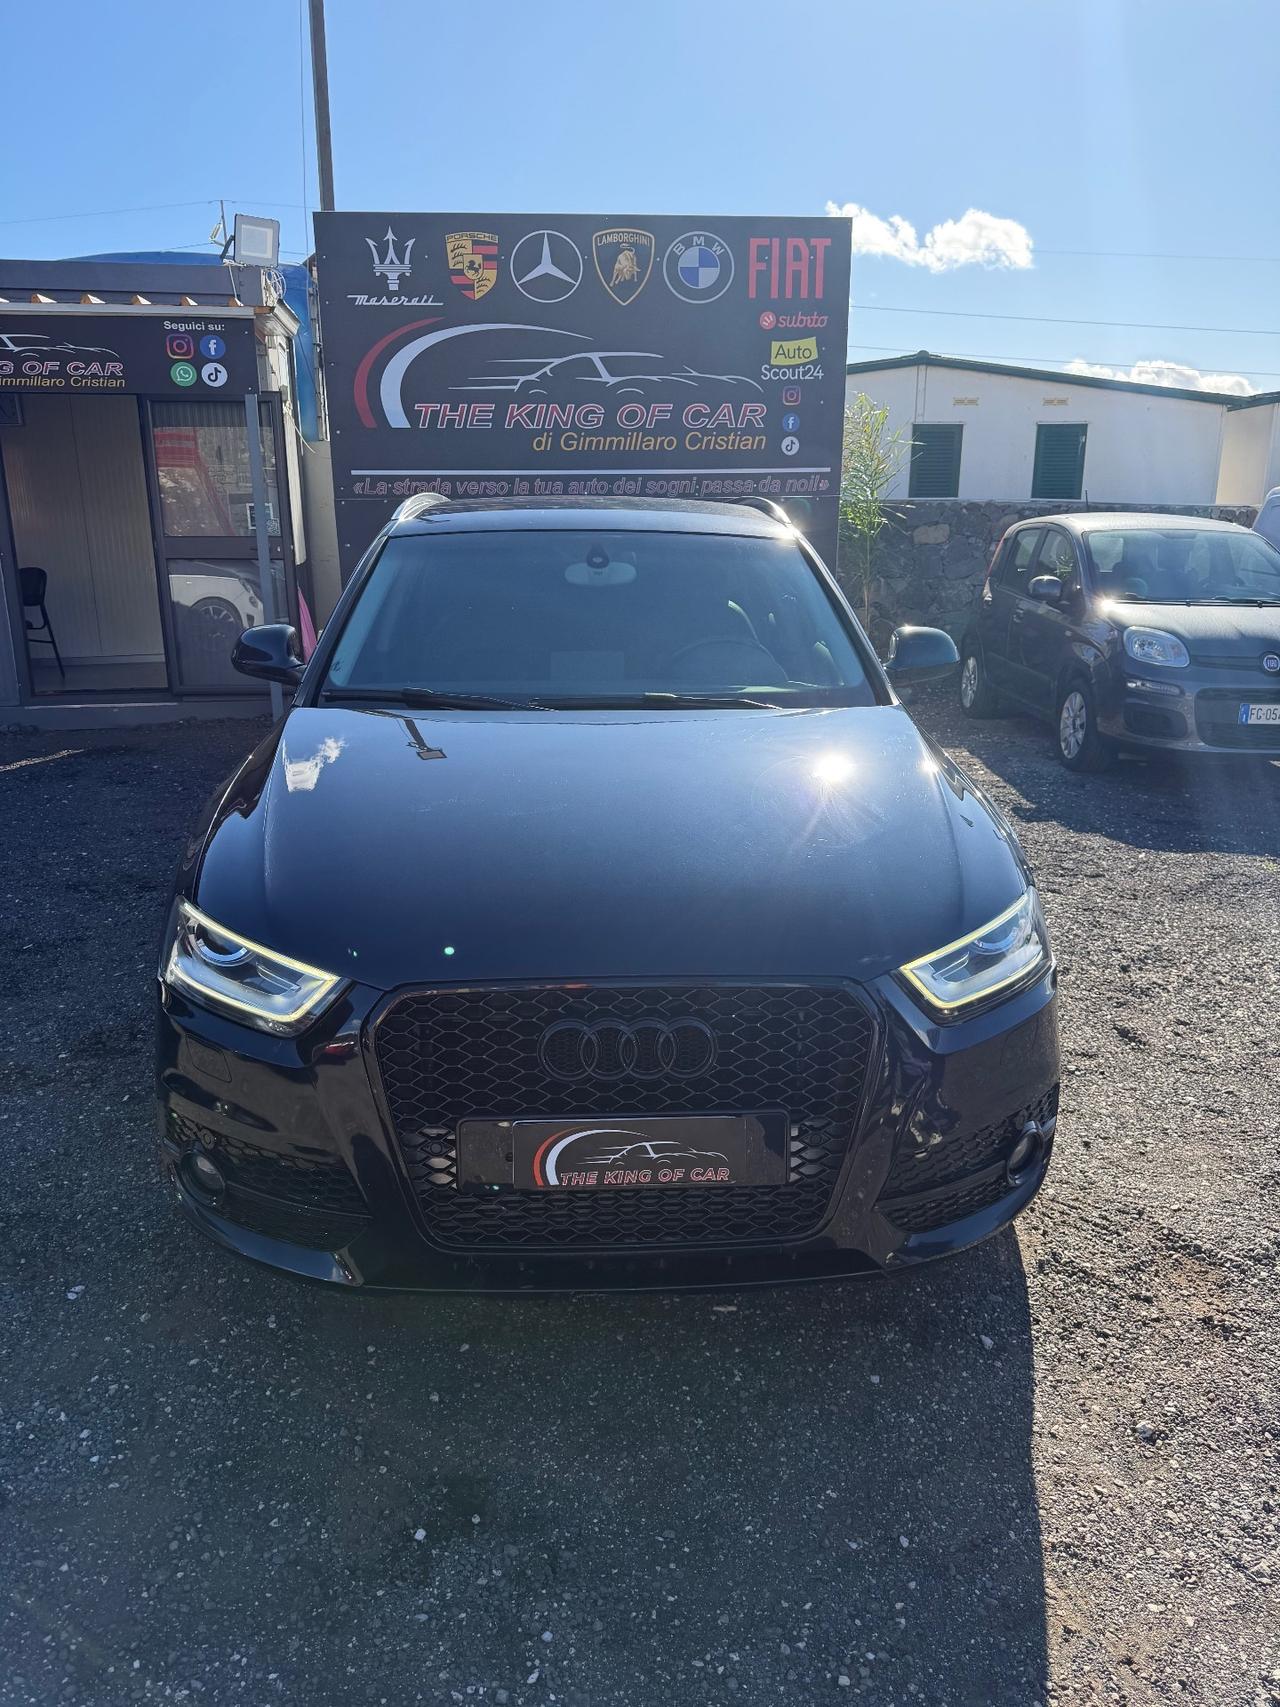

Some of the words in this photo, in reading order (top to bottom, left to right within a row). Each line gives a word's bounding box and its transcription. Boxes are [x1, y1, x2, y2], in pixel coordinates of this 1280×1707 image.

[446, 232, 498, 242] PORSCHE
[597, 232, 650, 246] LAMBORGHINI
[672, 235, 726, 256] BMW
[748, 237, 832, 299] FIAT
[346, 294, 444, 306] Maserati
[163, 320, 205, 332] Seguici
[207, 323, 225, 331] su:
[777, 311, 829, 328] subito
[774, 344, 813, 360] Auto
[22, 360, 60, 375] OF
[66, 361, 124, 376] CAR
[760, 364, 825, 381] Scout24
[70, 376, 126, 388] Cristian
[414, 403, 495, 429] THE
[504, 403, 605, 429] KING
[616, 403, 673, 429] OF
[682, 403, 767, 428] CAR
[532, 431, 553, 451] di
[560, 431, 677, 451] Gimmillaro
[685, 431, 767, 450] Cristian
[392, 477, 452, 495] strada
[455, 480, 509, 496] verso
[513, 477, 530, 495] la
[534, 478, 563, 495] tua
[567, 478, 609, 495] auto
[612, 476, 643, 494] dei
[645, 476, 698, 497] sogni
[699, 479, 754, 497] passa
[758, 475, 781, 493] da
[560, 1171, 599, 1186] THE
[603, 1169, 652, 1184] KING
[658, 1168, 685, 1182] OF
[690, 1167, 731, 1182] CAR
